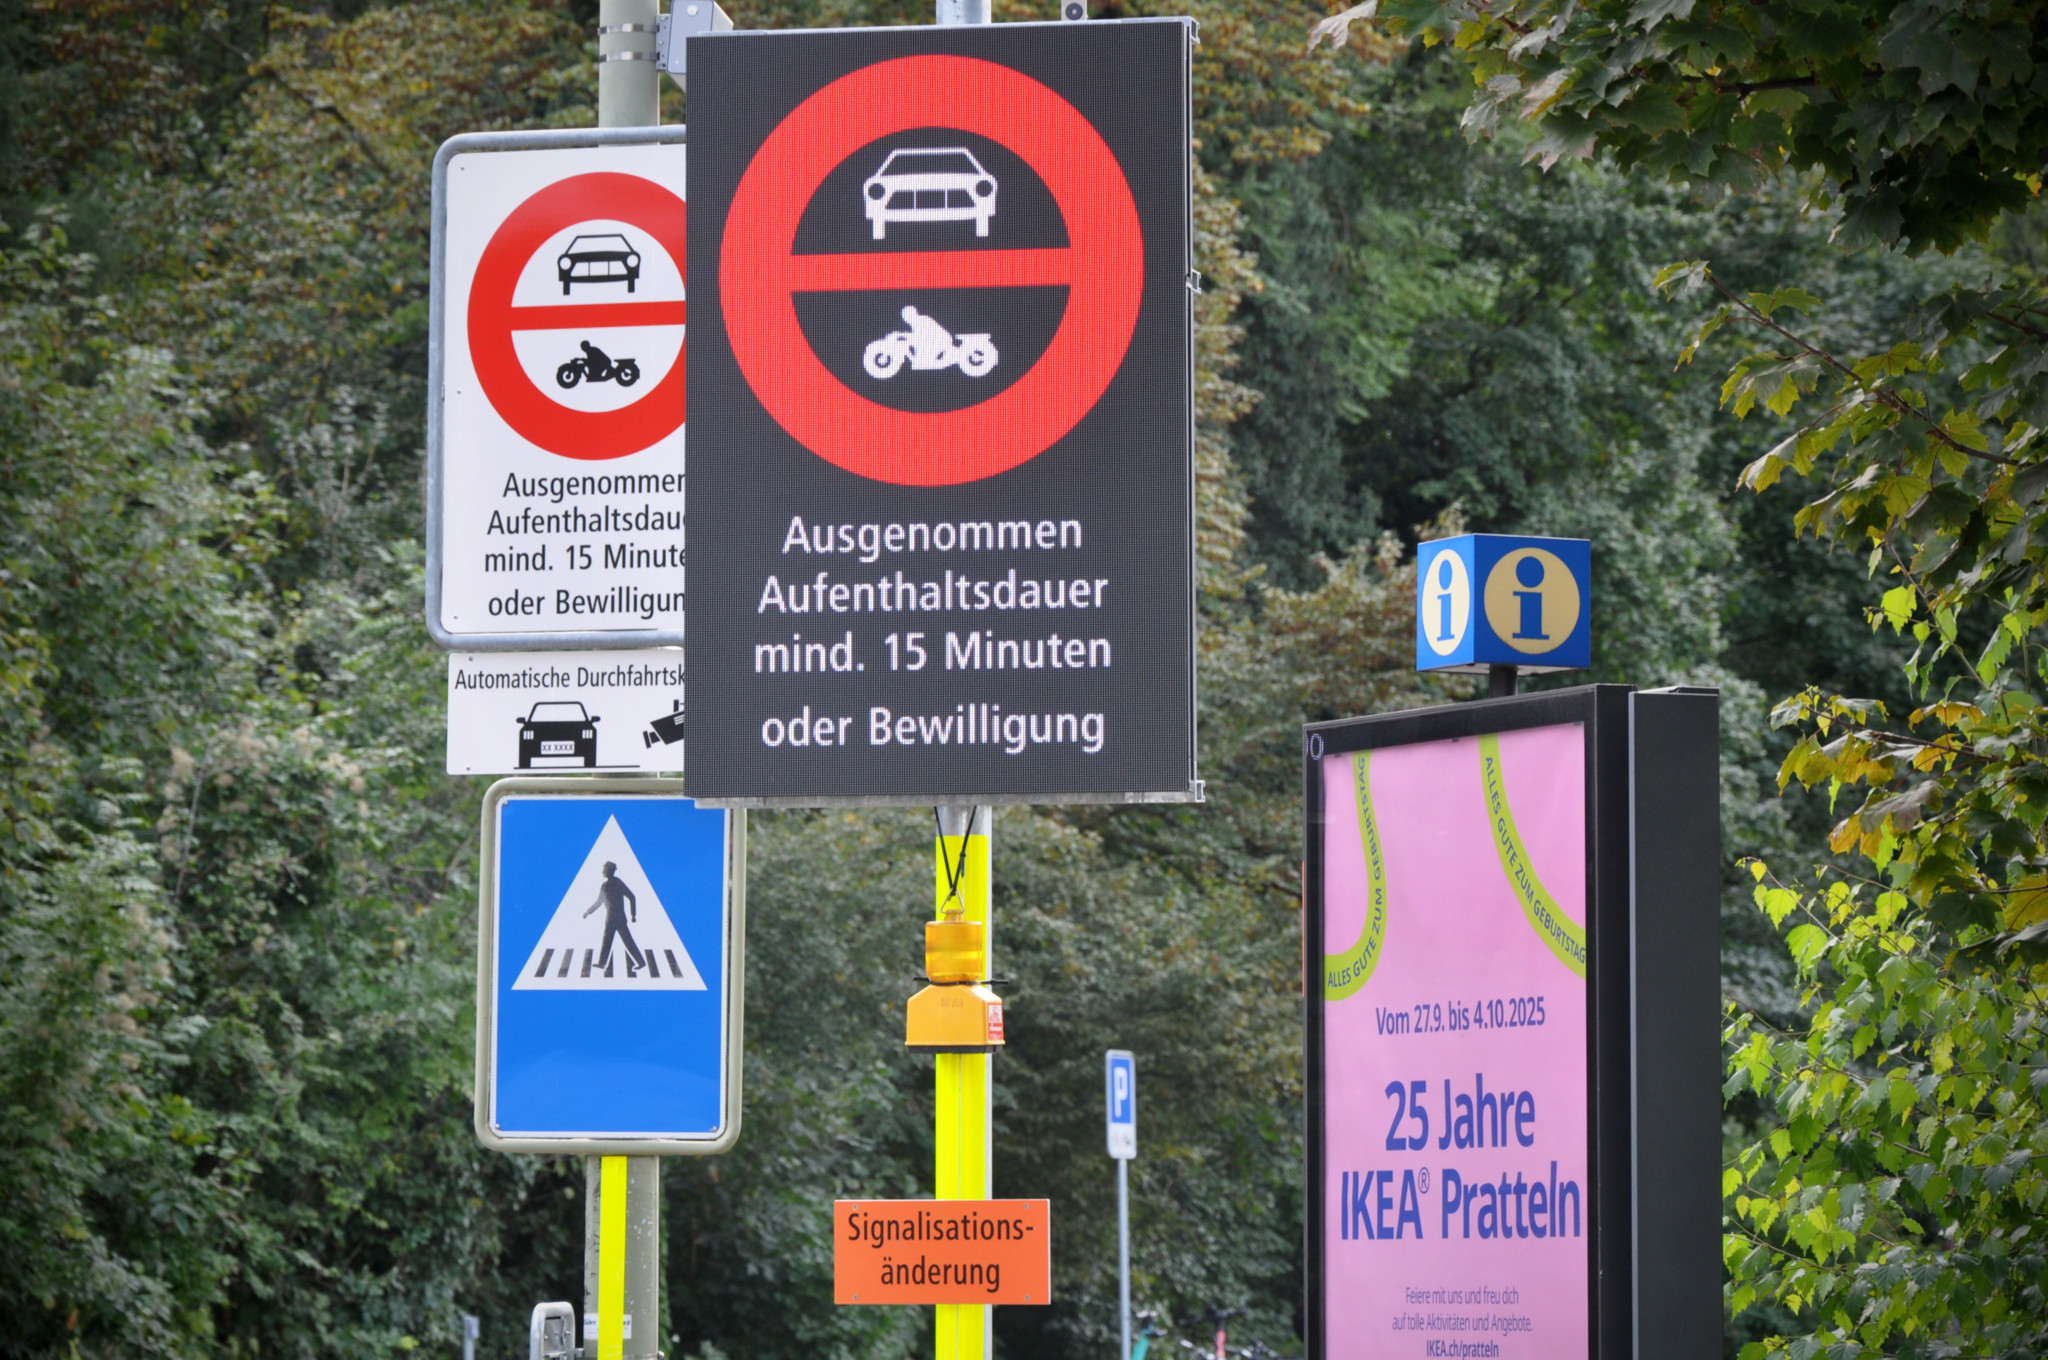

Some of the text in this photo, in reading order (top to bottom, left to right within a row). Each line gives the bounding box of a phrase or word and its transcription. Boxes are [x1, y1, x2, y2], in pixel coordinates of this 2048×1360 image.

[487, 504, 685, 535] Aufenthaltsdau
[485, 545, 553, 572] mind.
[566, 545, 592, 570] 15
[782, 516, 1083, 563] Ausgenommen
[488, 589, 545, 616] oder
[757, 569, 1109, 614] Aufenthaltsdauer
[755, 630, 1112, 673] mind. 15 Minuten
[455, 667, 570, 690] Automatische
[761, 703, 1105, 755] oder Bewilligung
[1328, 757, 1382, 988] ALLES GUTE ZUM GEBURTSTAG
[1485, 756, 1586, 964] ALLES GUTE ZUM GEBURTSTAG
[1375, 996, 1545, 1035] Vom 27.9. bis 4.10.2025
[1113, 1066, 1129, 1118] P
[1385, 1073, 1535, 1151] 25 Jahre
[1441, 1160, 1581, 1239] Pratteln
[848, 1211, 1034, 1248] Signalisations-
[880, 1256, 1000, 1292] änderung
[1405, 1285, 1519, 1304] Feiere mit uns und freu dich
[1392, 1312, 1533, 1337] auf tolle Aktivitäten und Angebote.
[1426, 1339, 1499, 1360] IKEA.ch/pratteln
